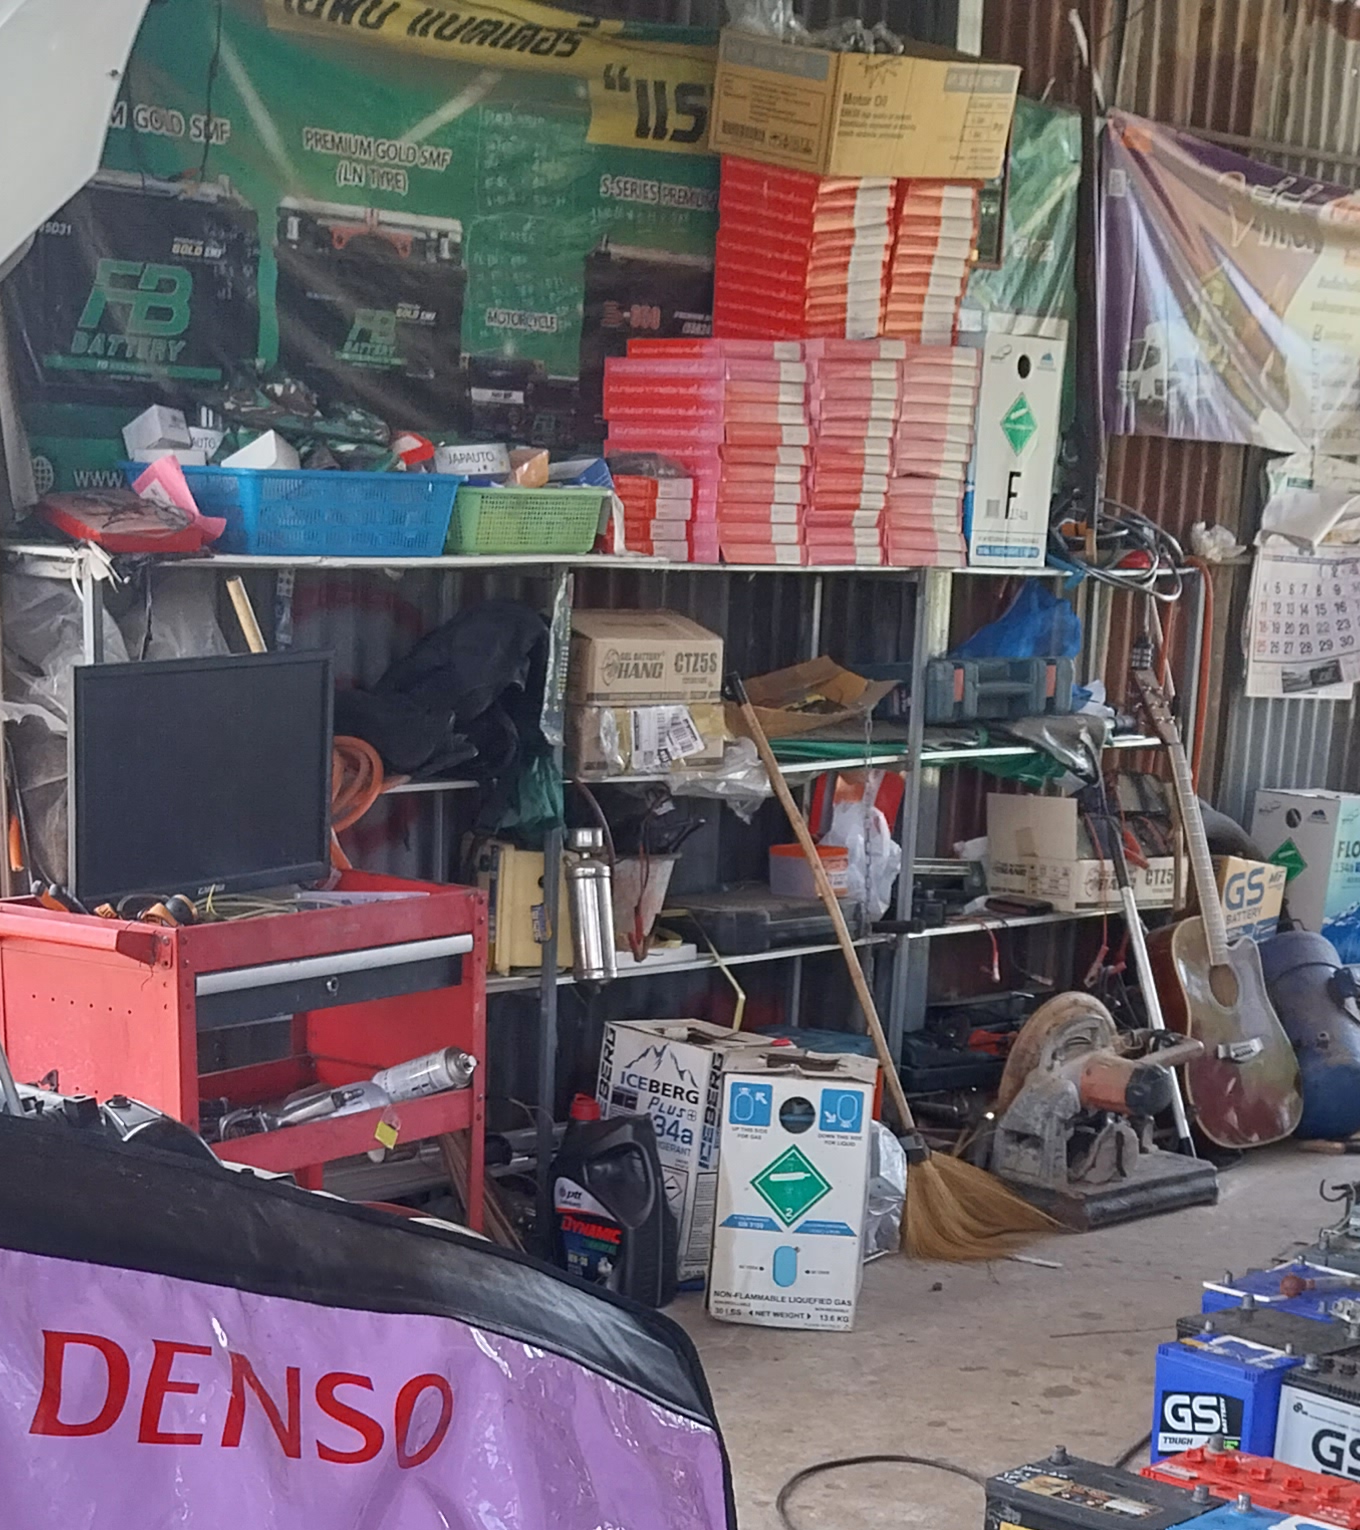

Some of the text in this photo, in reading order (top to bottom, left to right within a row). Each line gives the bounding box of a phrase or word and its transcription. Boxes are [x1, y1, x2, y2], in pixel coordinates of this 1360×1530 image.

[843, 93, 872, 106] Motor
[133, 104, 186, 137] GOLD
[190, 114, 231, 145] SMF
[304, 128, 452, 171] PREMIUM GOLD SMF
[337, 161, 409, 195] (LN TYPE)
[601, 174, 659, 205] S-SERIES
[77, 258, 193, 336] FB
[487, 308, 558, 332] MOTORCYCLE
[71, 330, 187, 361] BATTERY
[1273, 601, 1281, 615] 12
[1300, 602, 1309, 616] 14
[1315, 602, 1327, 616] 15
[1334, 600, 1347, 614] 16
[1284, 621, 1295, 635] 20
[1299, 622, 1310, 636] 21
[1316, 621, 1330, 634] 22
[1335, 618, 1351, 631] 23
[1283, 641, 1294, 655] 27
[1299, 641, 1313, 655] 28
[1319, 639, 1334, 652] 29
[1339, 635, 1355, 647] 30
[674, 652, 718, 673] CTZ5S
[1145, 869, 1175, 886] CTZ5
[1225, 866, 1266, 911] GS
[1226, 906, 1262, 925] BATTERY
[620, 1071, 700, 1105] ICEBERG
[647, 1096, 687, 1119] PLUS
[698, 1052, 725, 1170] ICEBERG
[653, 1114, 693, 1146] 34a
[566, 1190, 582, 1200] ptt
[785, 1207, 793, 1218] 2
[562, 1215, 622, 1244] DYNAMIC
[714, 1290, 852, 1307] NON-FLAMMABLE LIQUEFIED GAS
[773, 1311, 805, 1320] WEIGHT
[28, 1329, 454, 1469] DENSO
[1164, 1394, 1220, 1433] GS
[1163, 1436, 1193, 1446] TOUGH
